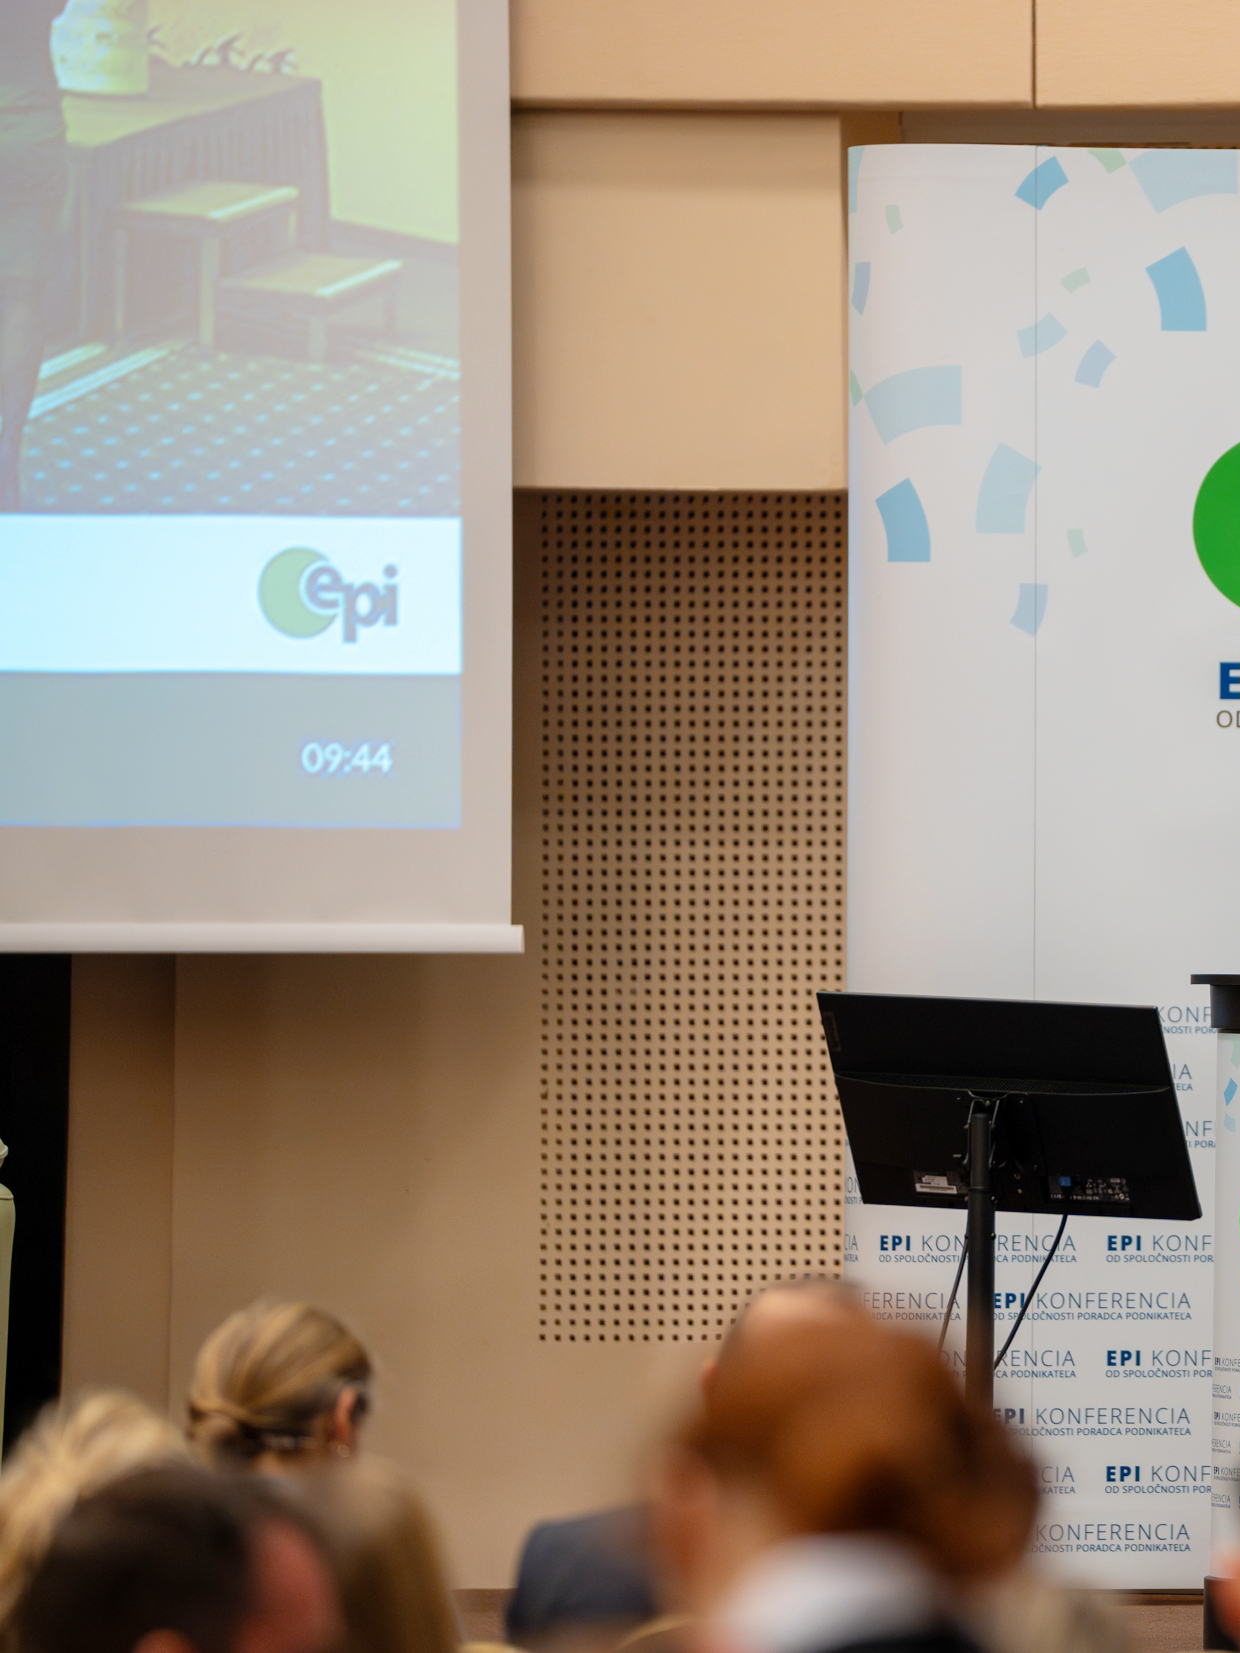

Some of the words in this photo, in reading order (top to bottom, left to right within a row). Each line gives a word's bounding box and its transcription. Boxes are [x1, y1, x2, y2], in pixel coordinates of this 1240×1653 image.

[305, 564, 398, 643] epi
[301, 742, 393, 774] 09:44
[880, 1235, 911, 1251] EPI
[1107, 1235, 1141, 1251] EPI
[879, 1254, 891, 1263] OD
[894, 1252, 959, 1263] SPOLOČNOSTI
[1106, 1254, 1119, 1263] OD
[1122, 1252, 1190, 1263] SPOLOČNOSTI
[1037, 1292, 1191, 1309] KONFERENCIA
[1078, 1311, 1123, 1320] PORADCA
[1125, 1310, 1192, 1320] PODNIKATEĽA
[997, 1350, 1076, 1367] RENCIA
[1107, 1350, 1141, 1366] EPI
[1011, 1368, 1076, 1378] PODNIKATEĽA
[1106, 1370, 1118, 1378] OD
[1123, 1367, 1190, 1378] SPOLOČNOSTI
[1036, 1408, 1191, 1424] KONFERENCIA
[1077, 1428, 1122, 1436] PORADCA
[1125, 1427, 1191, 1436] PODNIKATEĽA
[1106, 1466, 1140, 1482] EPI
[1105, 1486, 1119, 1494] OD
[1122, 1484, 1189, 1494] SPOLOČNOSTI
[1036, 1524, 1190, 1541] KONFERENCIA
[1076, 1544, 1121, 1552] PORADCA
[1124, 1543, 1191, 1552] PODNIKATEĽA
